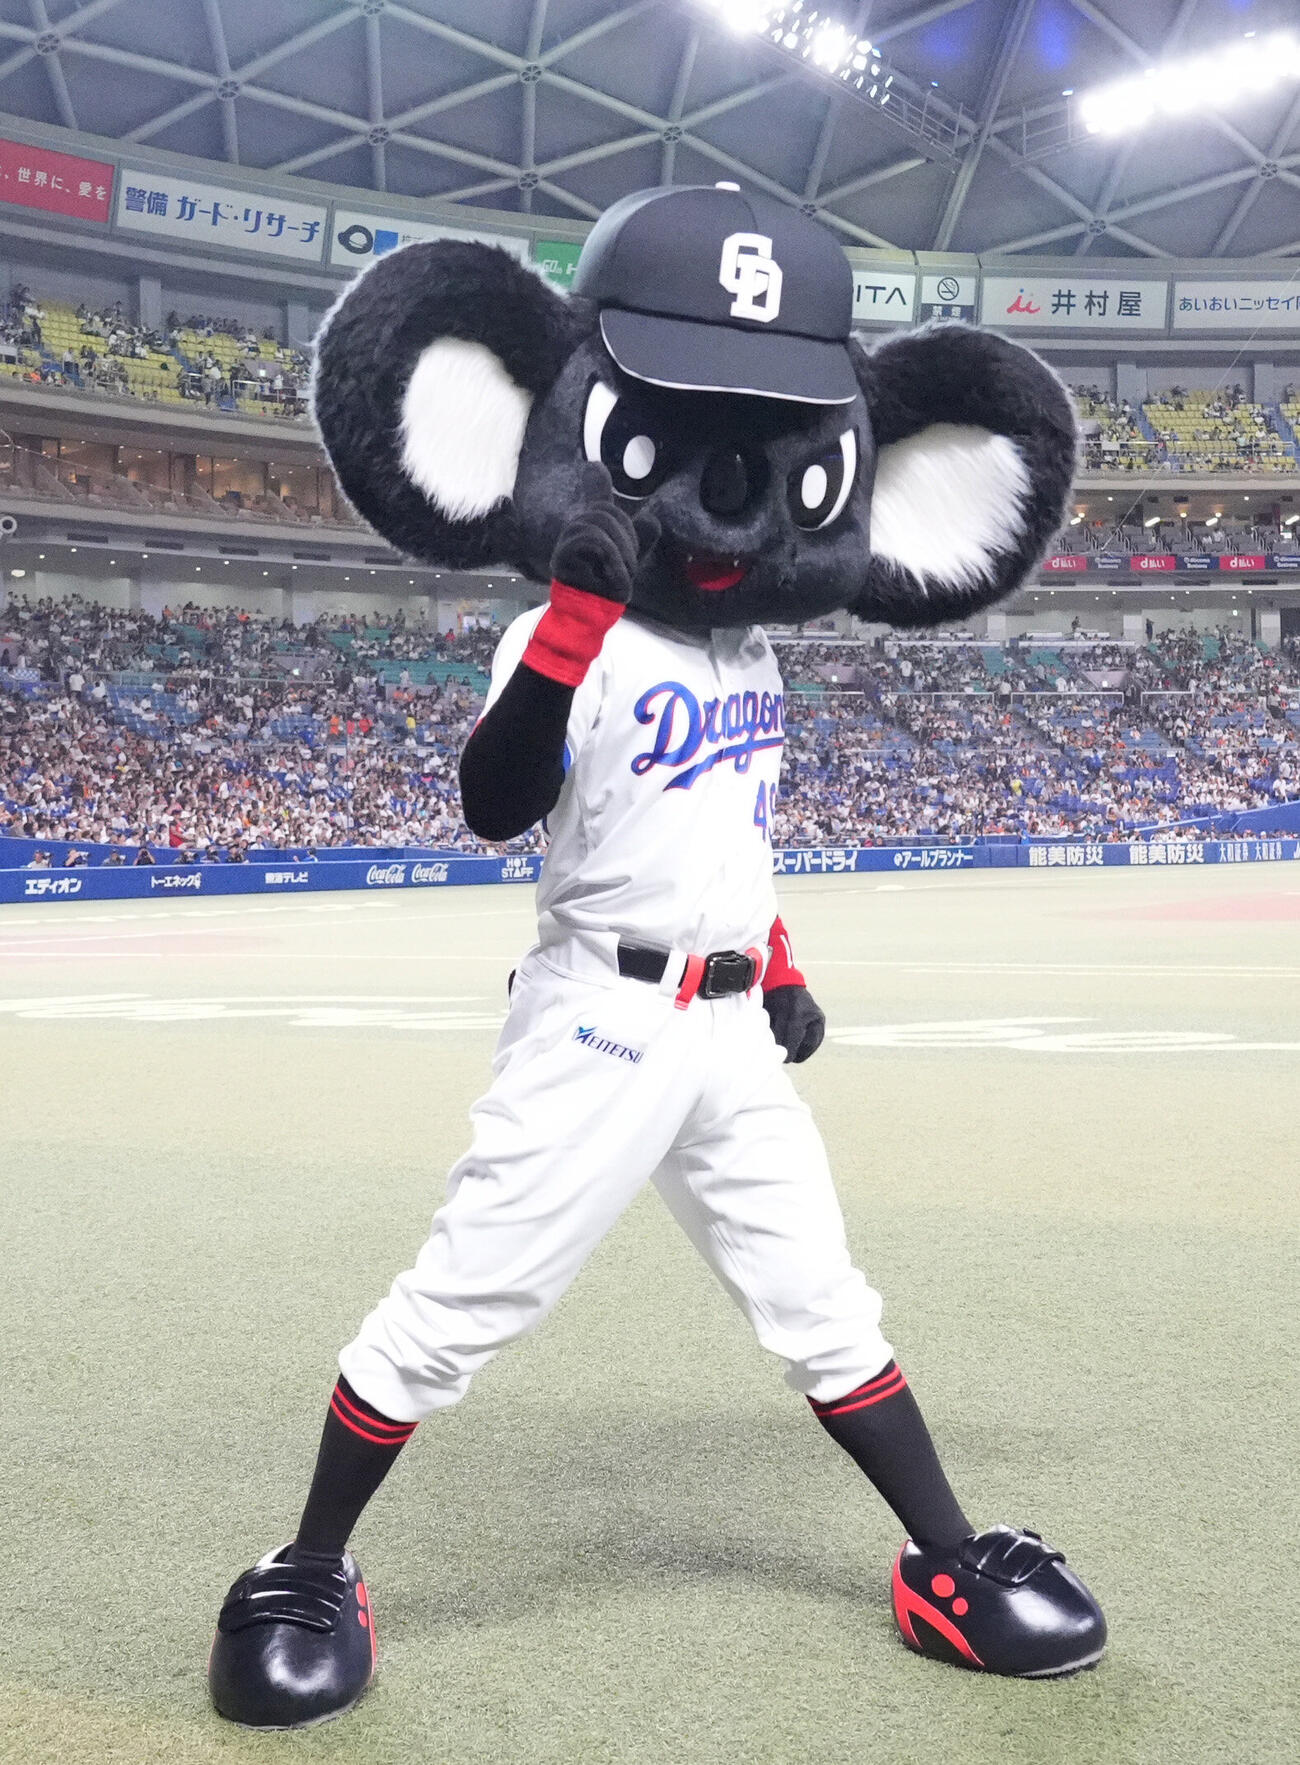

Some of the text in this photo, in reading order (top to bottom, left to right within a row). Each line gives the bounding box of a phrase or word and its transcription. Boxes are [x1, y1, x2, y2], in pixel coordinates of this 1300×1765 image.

[0, 165, 107, 200] 、世界に、愛を
[125, 186, 169, 217] 警備
[1051, 289, 1142, 316] 井村屋
[506, 858, 527, 868] HOT
[1028, 846, 1104, 866] 能美防災
[1129, 843, 1204, 864] 能美防災
[501, 867, 534, 879] STAFF
[25, 877, 82, 895] エディオン
